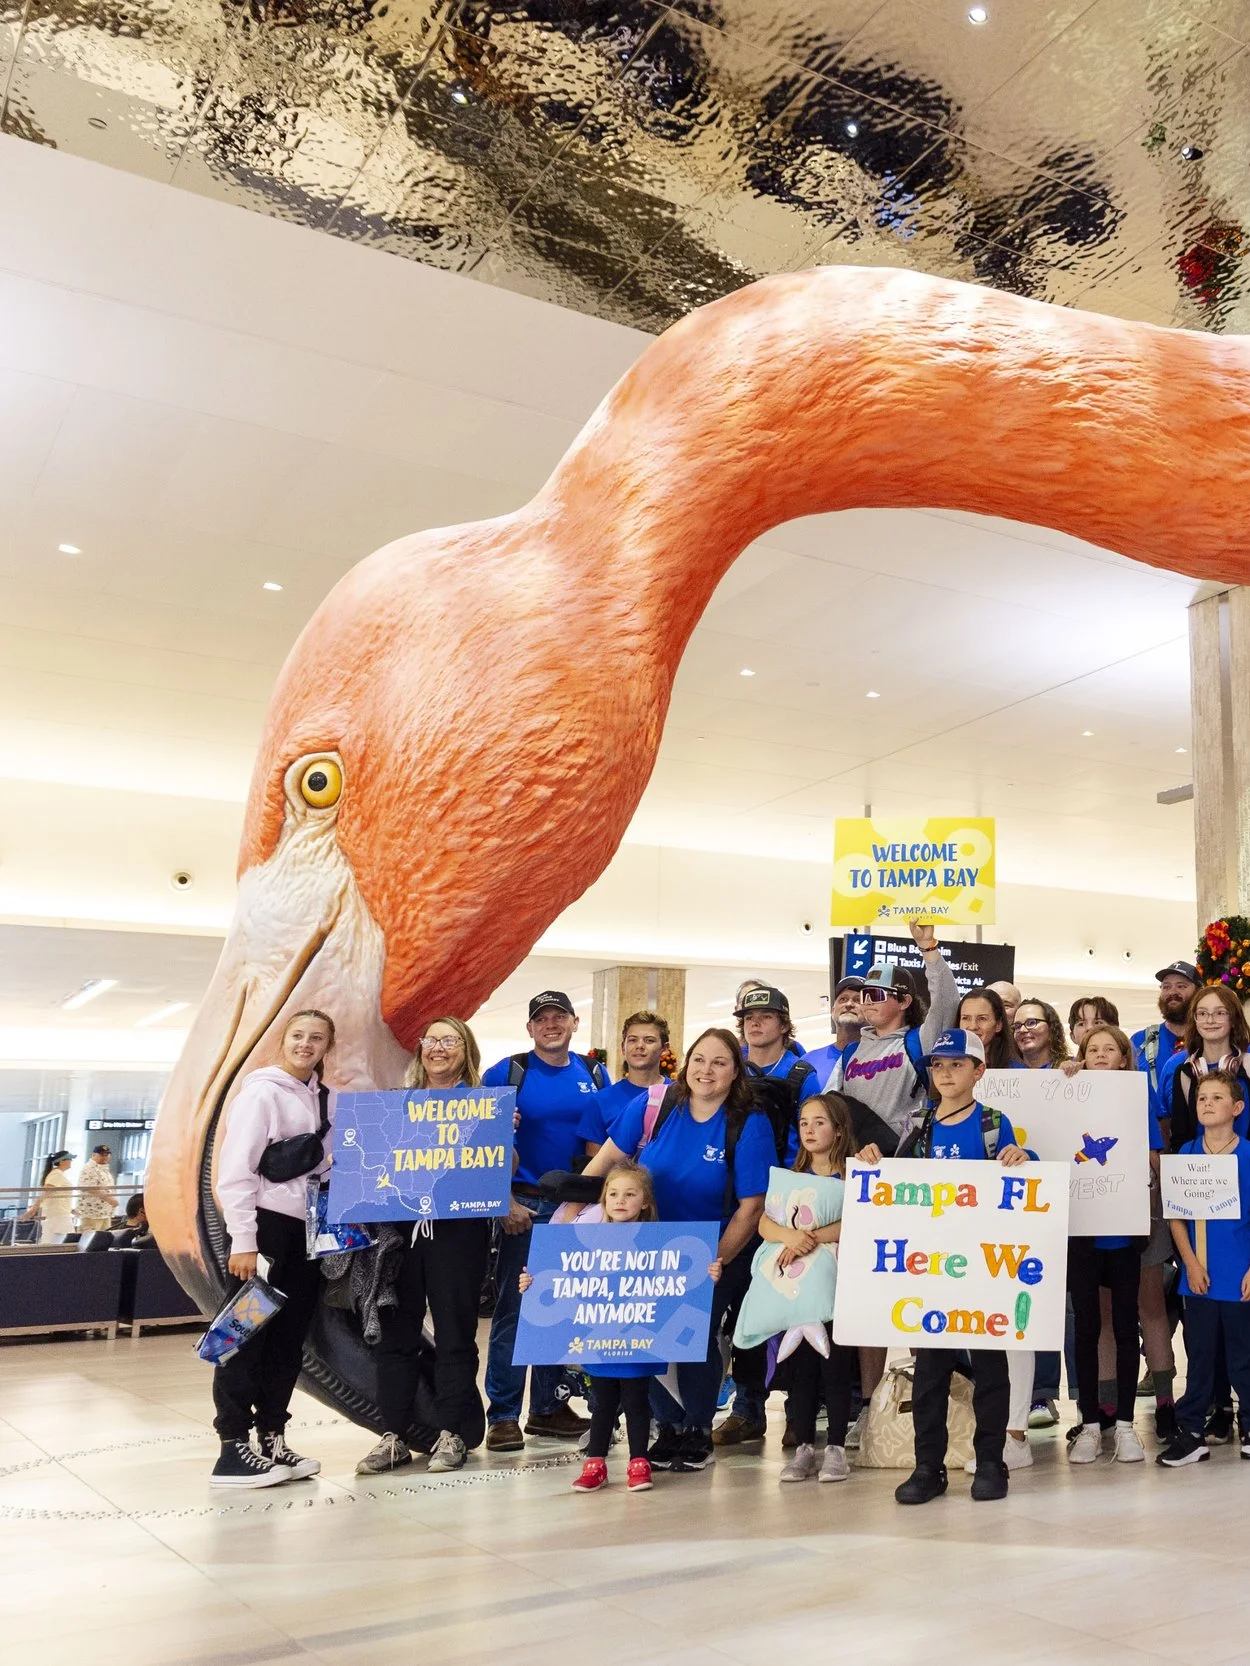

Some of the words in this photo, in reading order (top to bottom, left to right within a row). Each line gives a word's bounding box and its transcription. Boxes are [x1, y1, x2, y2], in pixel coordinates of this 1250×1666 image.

[872, 843, 958, 862] WELCOME
[850, 869, 872, 888] TO
[877, 868, 938, 888] TAMPA
[943, 868, 979, 887] BAY
[893, 906, 927, 914] TAMPA
[931, 906, 949, 914] BAY
[887, 943, 907, 953] Blue
[972, 977, 984, 986] Air
[975, 1077, 1021, 1099] HANK
[1040, 1079, 1092, 1103] YOU
[408, 1098, 497, 1122] WELCOME
[436, 1123, 460, 1145] TO
[393, 1148, 456, 1172] TAMPA
[461, 1146, 505, 1169] BAY!
[1187, 1163, 1210, 1172] Wait!
[1069, 1173, 1125, 1200] EST
[1171, 1176, 1198, 1185] Where
[851, 1169, 979, 1218] Tampa
[997, 1176, 1050, 1213] FL
[1184, 1189, 1215, 1200] Going?
[461, 1201, 486, 1209] TAMPA
[488, 1200, 502, 1208] BAY
[1166, 1199, 1193, 1216] Tampa
[1208, 1195, 1238, 1213] Tampa
[560, 1249, 621, 1272] YOU'RE
[624, 1250, 658, 1271] NOT
[661, 1250, 681, 1271] IN
[872, 1239, 968, 1279] Here
[980, 1242, 1044, 1285] We
[552, 1276, 615, 1301] TAMPA,
[618, 1276, 687, 1297] KANSAS
[573, 1302, 657, 1325] ANYMORE
[891, 1291, 1032, 1340] Come!
[586, 1339, 627, 1350] TAMPA
[630, 1338, 654, 1349] BAY
